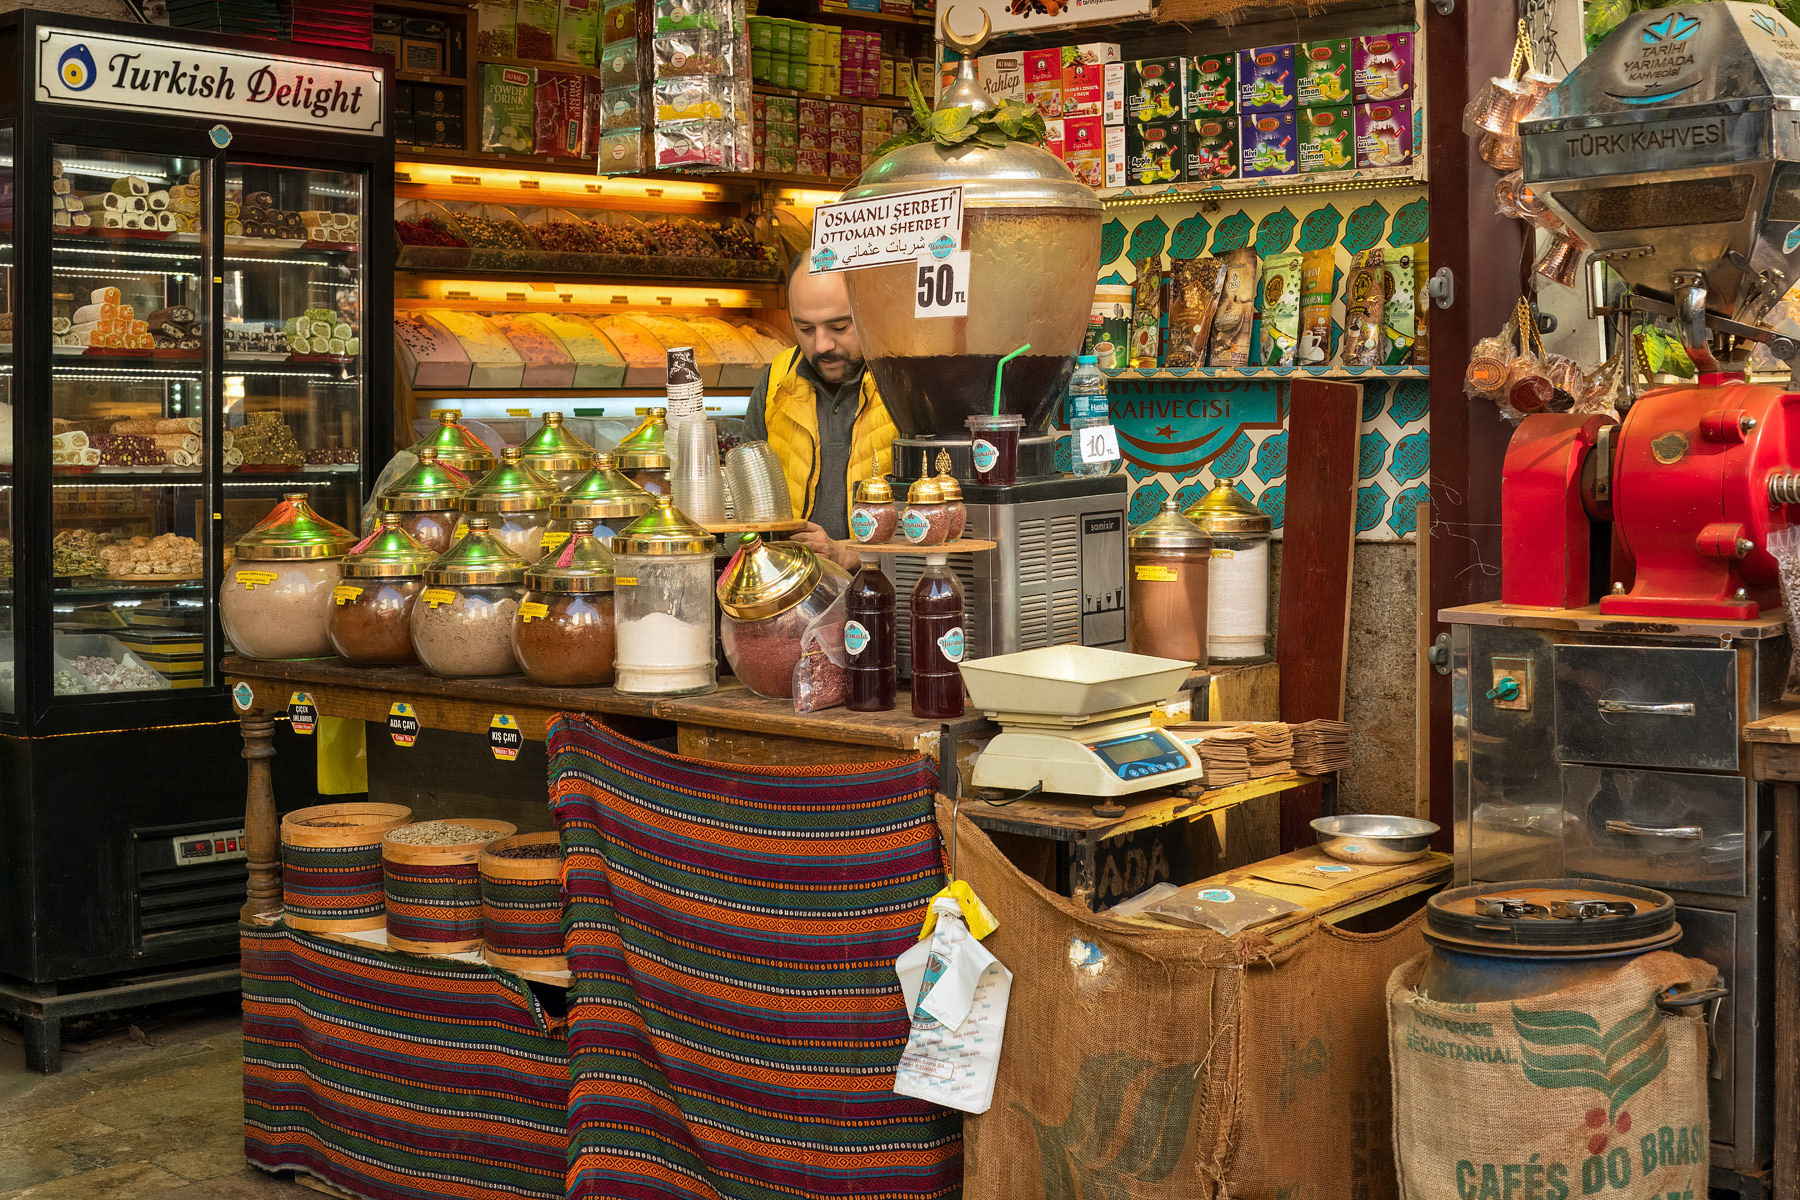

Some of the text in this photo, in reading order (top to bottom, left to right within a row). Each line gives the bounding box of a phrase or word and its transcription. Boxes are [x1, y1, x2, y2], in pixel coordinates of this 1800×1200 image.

[1642, 42, 1686, 58] TARİHİ
[1624, 54, 1694, 72] YARIMADA
[108, 53, 363, 118] Turkish Delight
[984, 73, 1020, 94] Sahlep
[490, 84, 528, 96] POWDER
[494, 94, 524, 105] DRINK
[773, 98, 787, 106] TEA
[807, 101, 818, 109] TEA
[1130, 96, 1145, 104] Elma
[836, 103, 848, 111] TEA
[838, 128, 851, 137] TEA
[1566, 119, 1726, 158] TÜRK KAHVESİ
[804, 151, 818, 160] TEA
[836, 153, 848, 161] TEA
[1189, 155, 1199, 163] Nar
[1244, 149, 1257, 157] Kivi
[1301, 152, 1324, 160] Limon
[1132, 157, 1150, 166] Apple
[824, 194, 953, 228] OSMANLI ŞERBETİ
[820, 216, 950, 244] OTTOMAN SHERBET
[842, 236, 925, 266] شربات عثماني
[918, 264, 966, 308] 50 TL
[1087, 434, 1105, 457] 10
[1091, 521, 1114, 531] samixir
[390, 718, 416, 731] ADA ÇAYI
[492, 731, 517, 744] KIŞ ÇAYI
[1456, 1153, 1569, 1200] CAFÉS
[1582, 1147, 1631, 1195] DO
